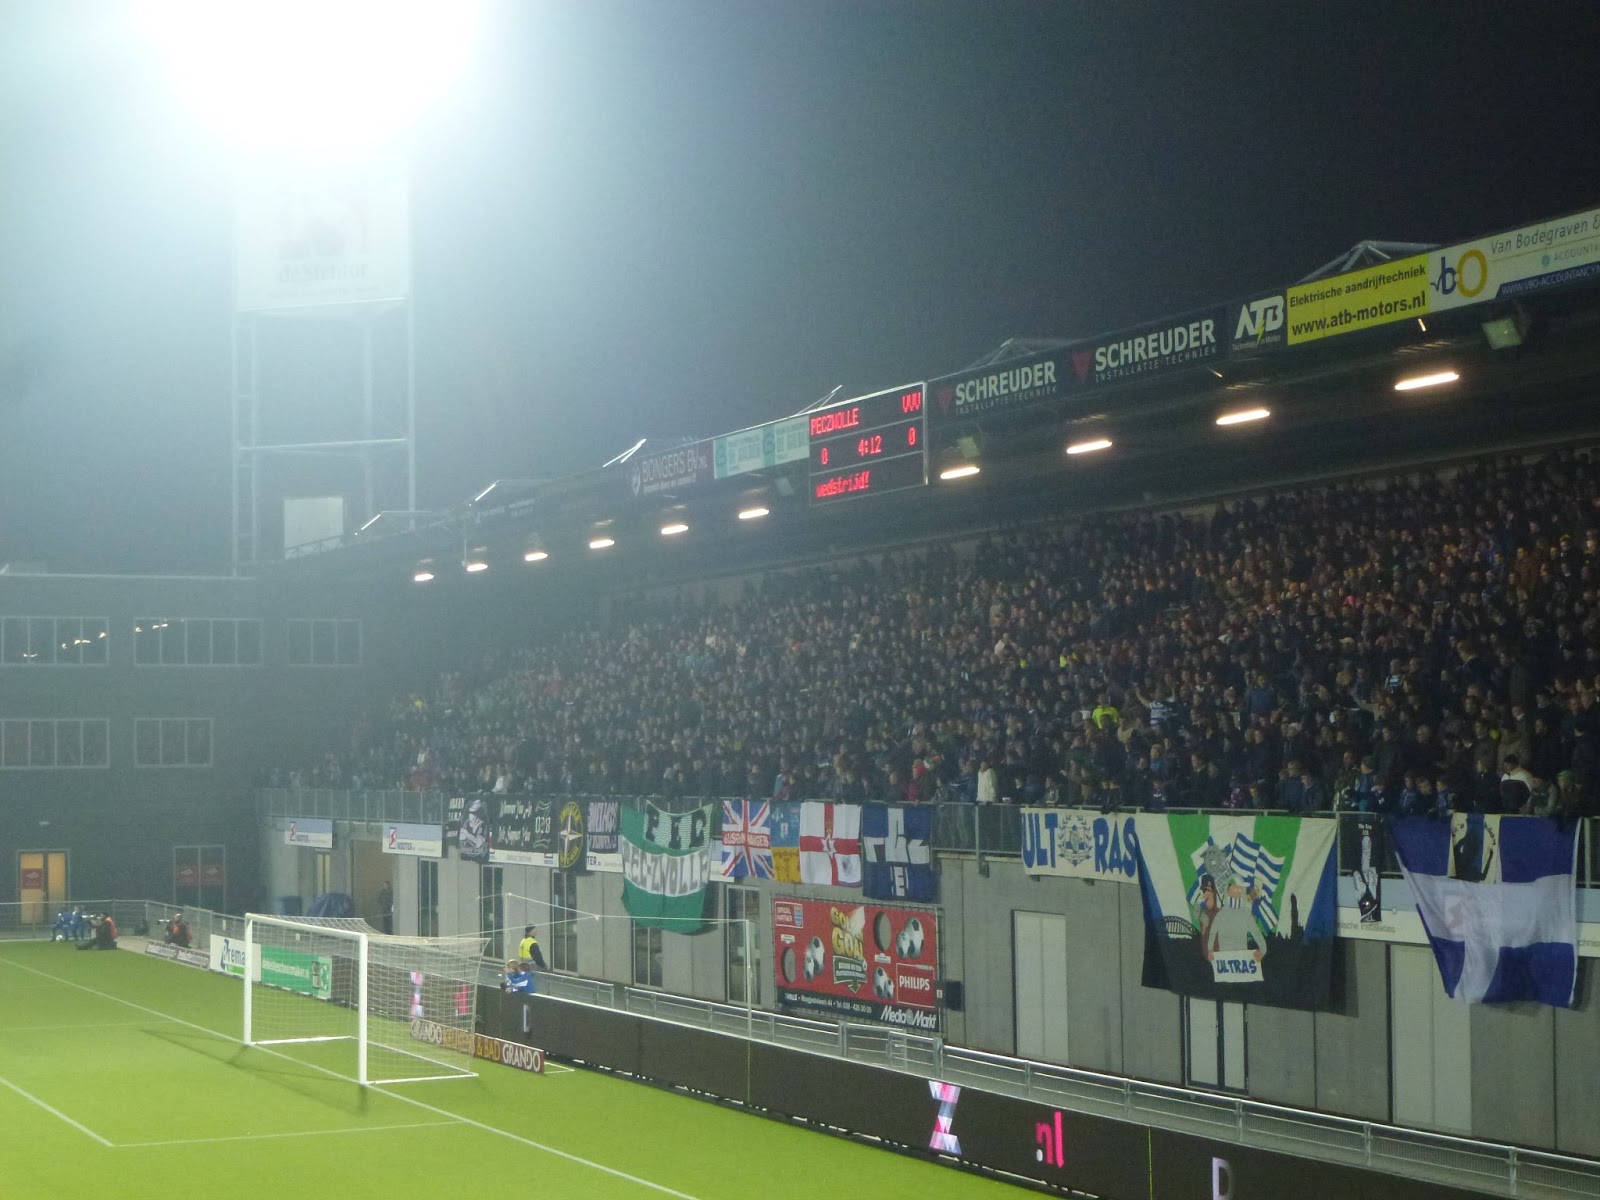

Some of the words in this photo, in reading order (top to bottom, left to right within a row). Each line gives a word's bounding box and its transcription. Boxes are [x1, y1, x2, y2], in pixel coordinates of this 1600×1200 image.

[1490, 240, 1512, 255] Van
[1516, 220, 1588, 250] Bodegraven
[1290, 286, 1342, 308] Elektrische
[1345, 264, 1426, 294] aandrijftechniek
[1234, 295, 1285, 340] ATB
[1292, 290, 1426, 336] www.atb-motors.nl
[1095, 319, 1216, 372] SCHREUDER
[955, 361, 1057, 405] SCHREUDER
[1096, 361, 1159, 383] INSTALLATIE
[1165, 346, 1217, 365] TECHNIEK
[955, 397, 1009, 416] INSTALLATIE
[1012, 385, 1057, 404] TECHNIEK
[821, 447, 829, 465] 0
[858, 435, 882, 457] 4:12
[908, 427, 917, 445] 0
[899, 975, 930, 991] PHILIPS
[1216, 959, 1257, 974] ULTRAS
[880, 1005, 907, 1022] Media
[912, 1010, 937, 1029] Markt
[485, 1041, 501, 1061] BAD
[502, 1043, 541, 1072] GRANDO
